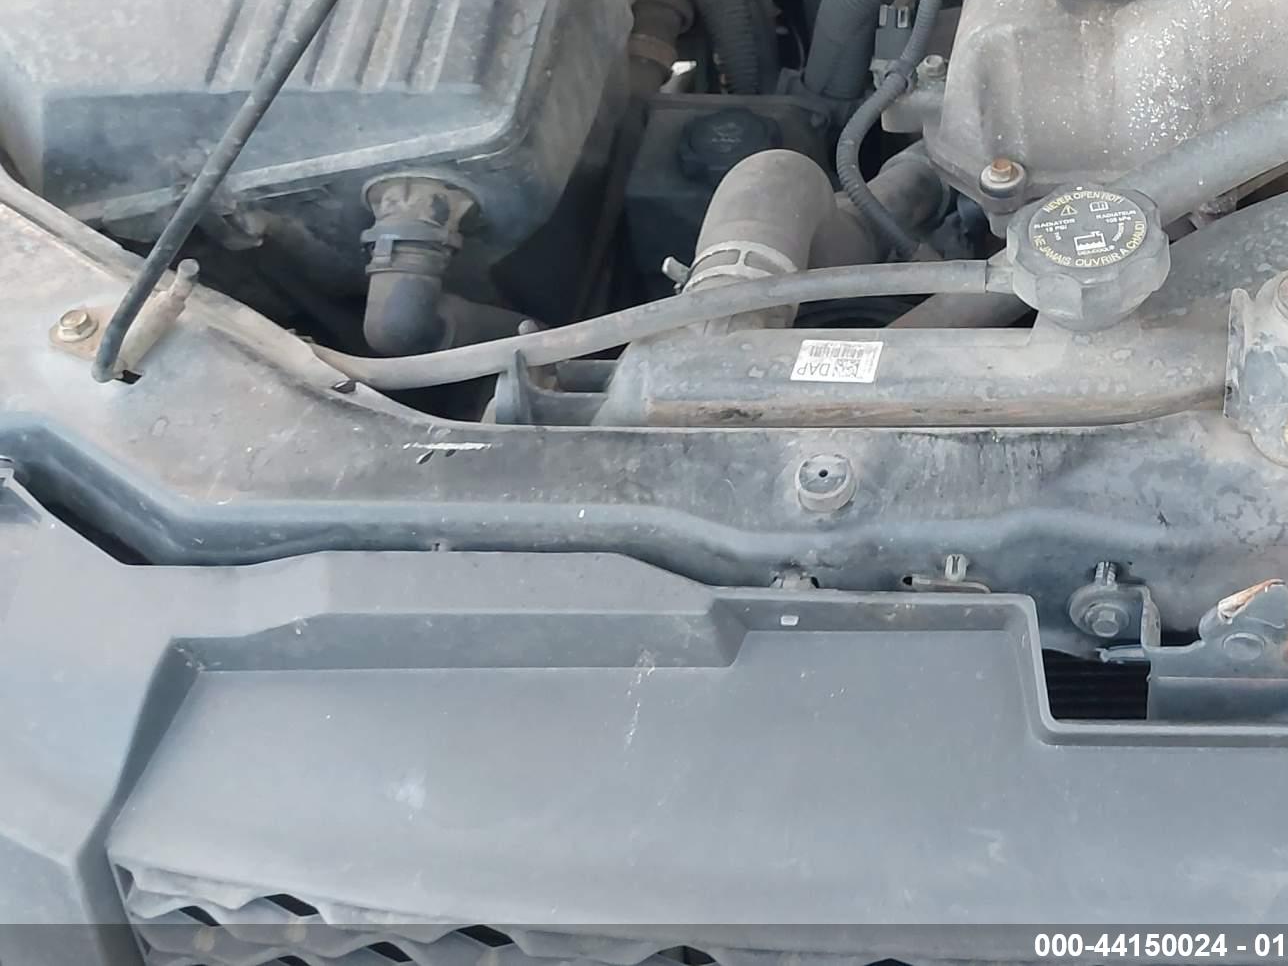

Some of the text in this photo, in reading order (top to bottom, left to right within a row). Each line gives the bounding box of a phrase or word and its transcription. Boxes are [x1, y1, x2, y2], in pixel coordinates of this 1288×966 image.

[1042, 190, 1125, 213] NEVER OPEN HOT!
[1095, 210, 1137, 220] RADIATEUR
[1033, 218, 1076, 229] RADIATOR
[1040, 245, 1072, 266] JAMAIS
[1075, 254, 1121, 266] OUVRIR
[797, 362, 831, 376] DAP
